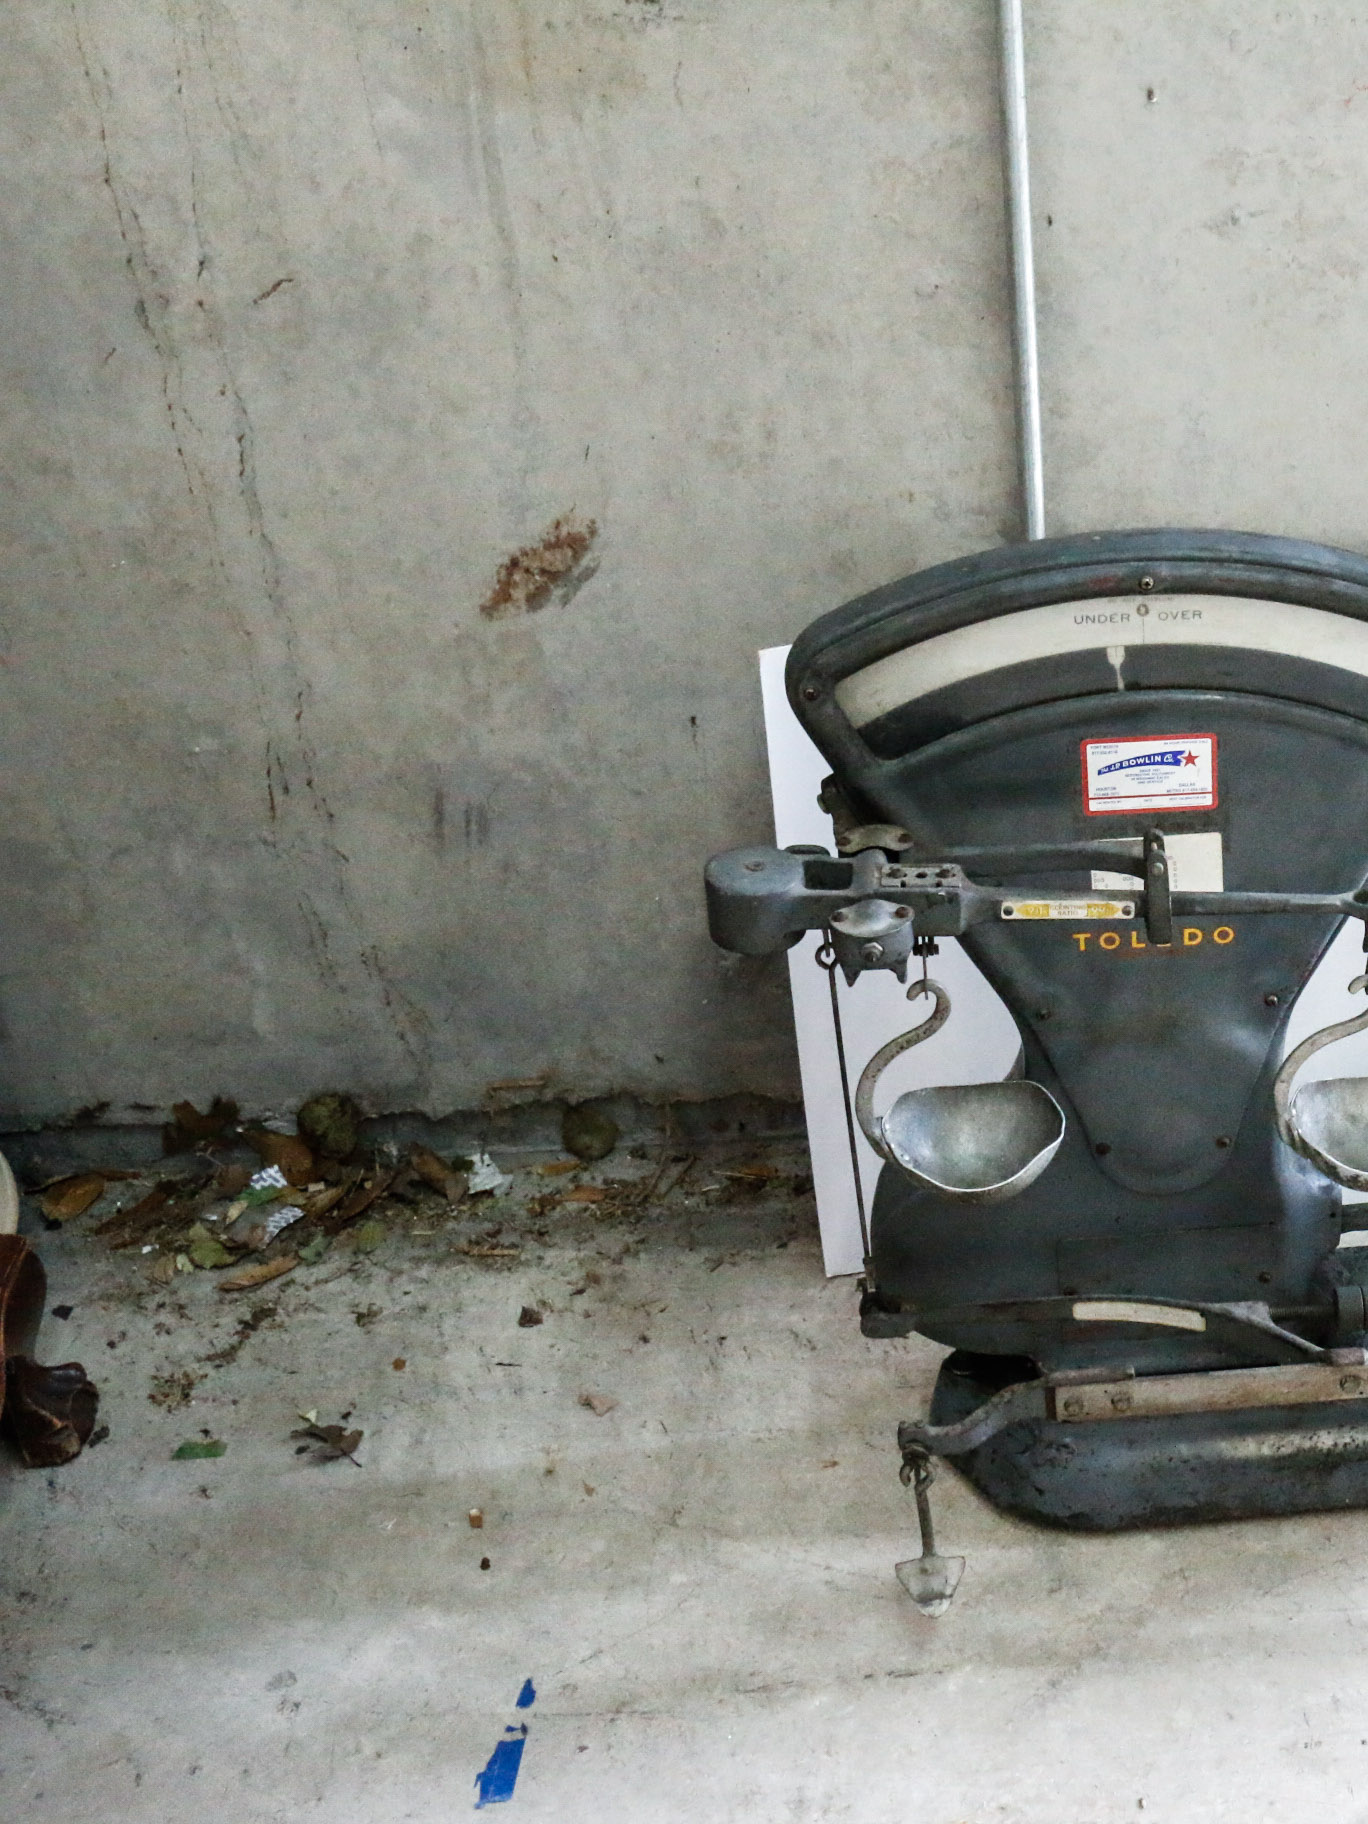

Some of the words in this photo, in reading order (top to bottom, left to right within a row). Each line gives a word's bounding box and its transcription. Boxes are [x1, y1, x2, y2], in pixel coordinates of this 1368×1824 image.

[1073, 613, 1131, 625] UNDER
[1157, 610, 1203, 622] OVER
[1122, 755, 1161, 767] BOWLIN
[1072, 926, 1235, 951] TOLDO
